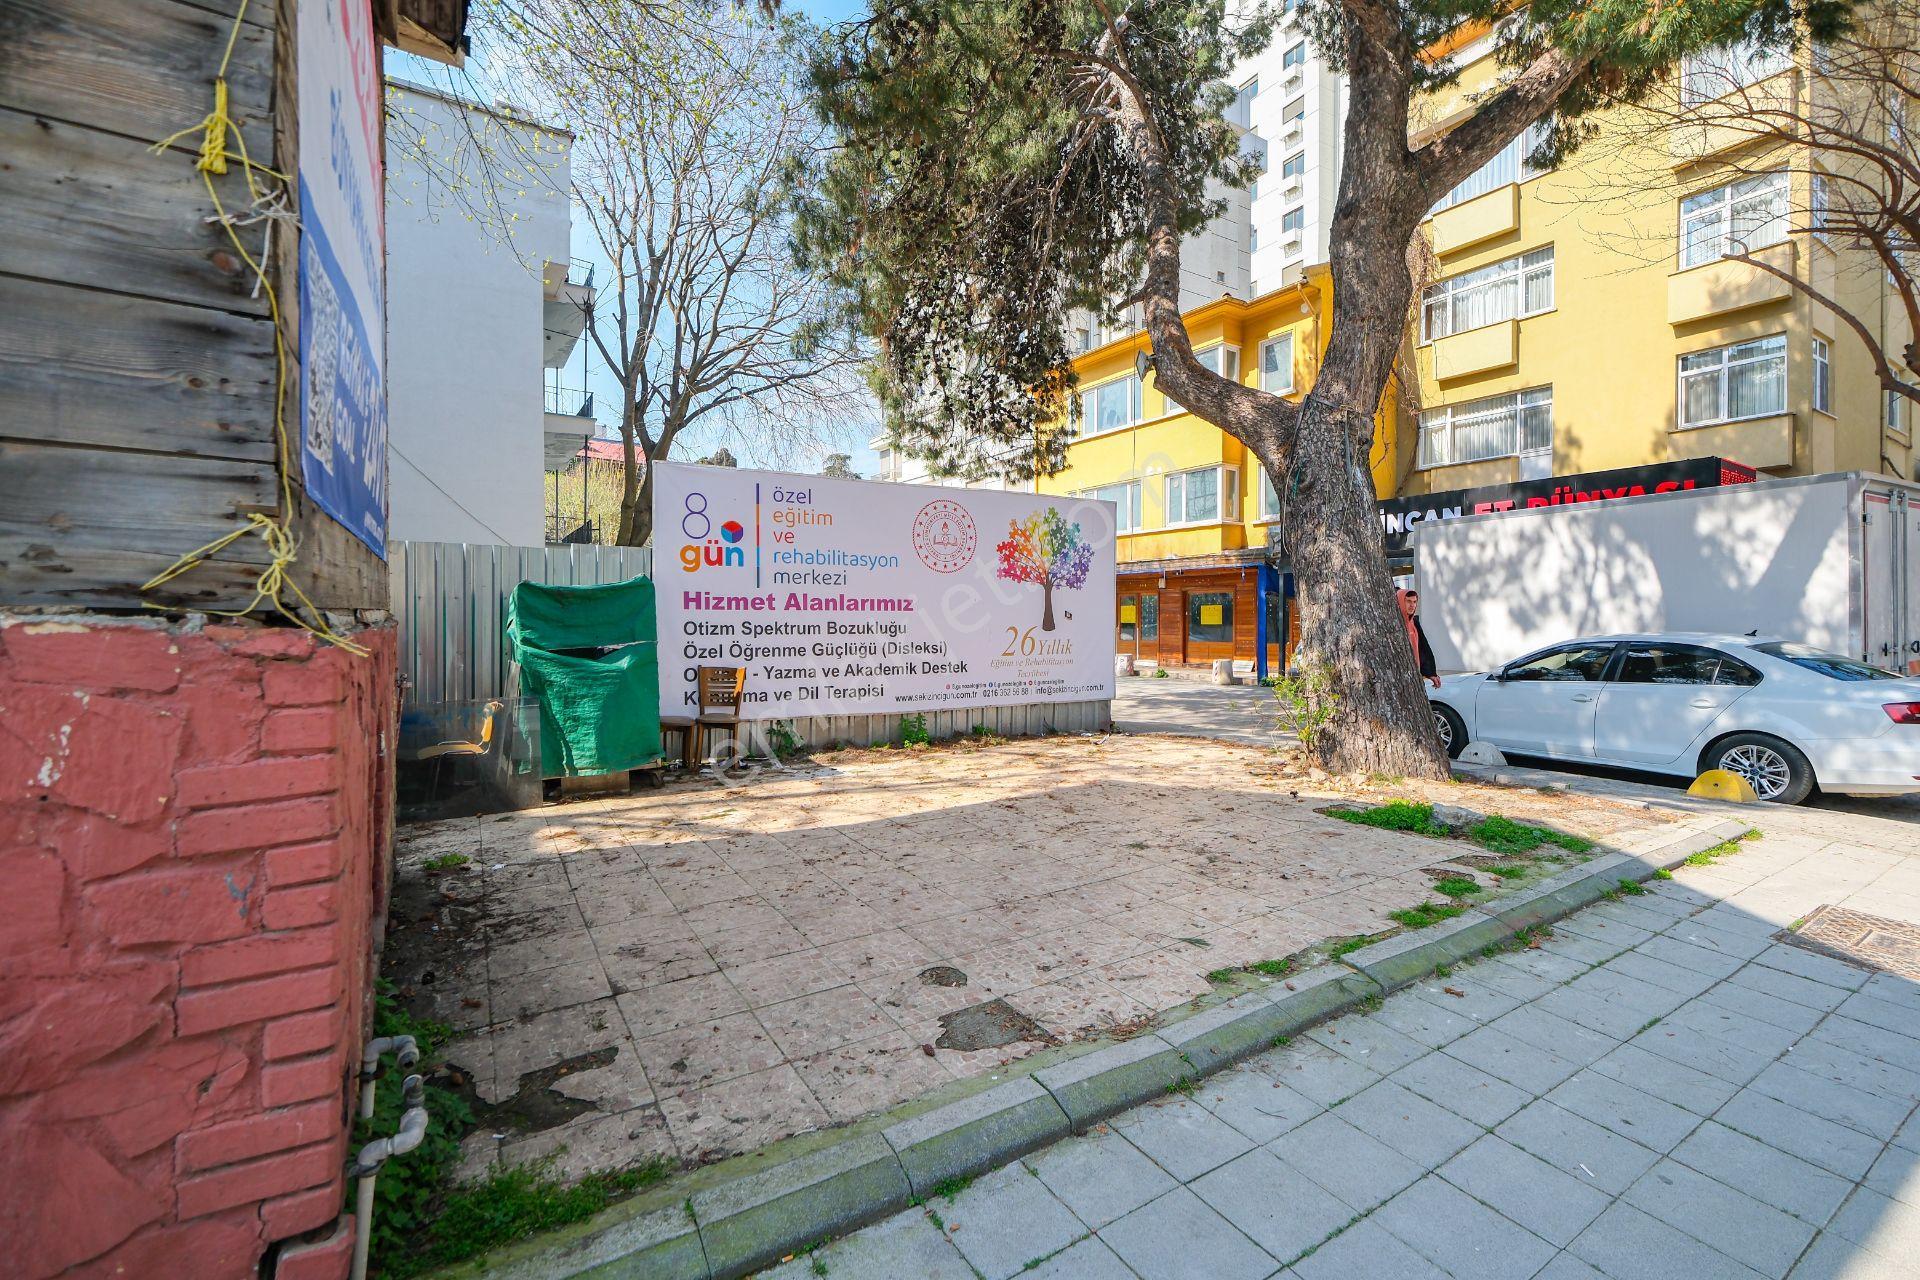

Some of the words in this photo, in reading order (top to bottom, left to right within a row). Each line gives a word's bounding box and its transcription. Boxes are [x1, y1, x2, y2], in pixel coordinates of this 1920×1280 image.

[773, 486, 812, 505] özel
[681, 492, 711, 540] 8
[773, 507, 833, 528] eğitim
[773, 531, 795, 544] ve
[679, 540, 744, 573] gün
[773, 548, 898, 571] rehabilitasyon
[773, 569, 847, 586] merkezi
[683, 591, 776, 611] Hizmet
[784, 592, 914, 612] Alanlarımız
[683, 621, 735, 636] Otizm
[741, 621, 821, 640] Spektrum
[827, 621, 907, 639] Bozukluğu
[1001, 626, 1038, 656] 26
[1038, 639, 1072, 655] Yıllık
[683, 642, 723, 660] Özel
[729, 641, 806, 661] Öğrenme
[812, 642, 877, 658] Güçlüğü
[882, 641, 947, 658] (Disleksi)
[763, 665, 817, 680] Yazma
[822, 667, 840, 679] ve
[844, 662, 917, 678] Akademik
[922, 661, 968, 676] Destek
[774, 690, 792, 702] ve
[798, 686, 819, 701] Dil
[824, 684, 885, 701] Terapisi
[983, 689, 998, 698] 0216
